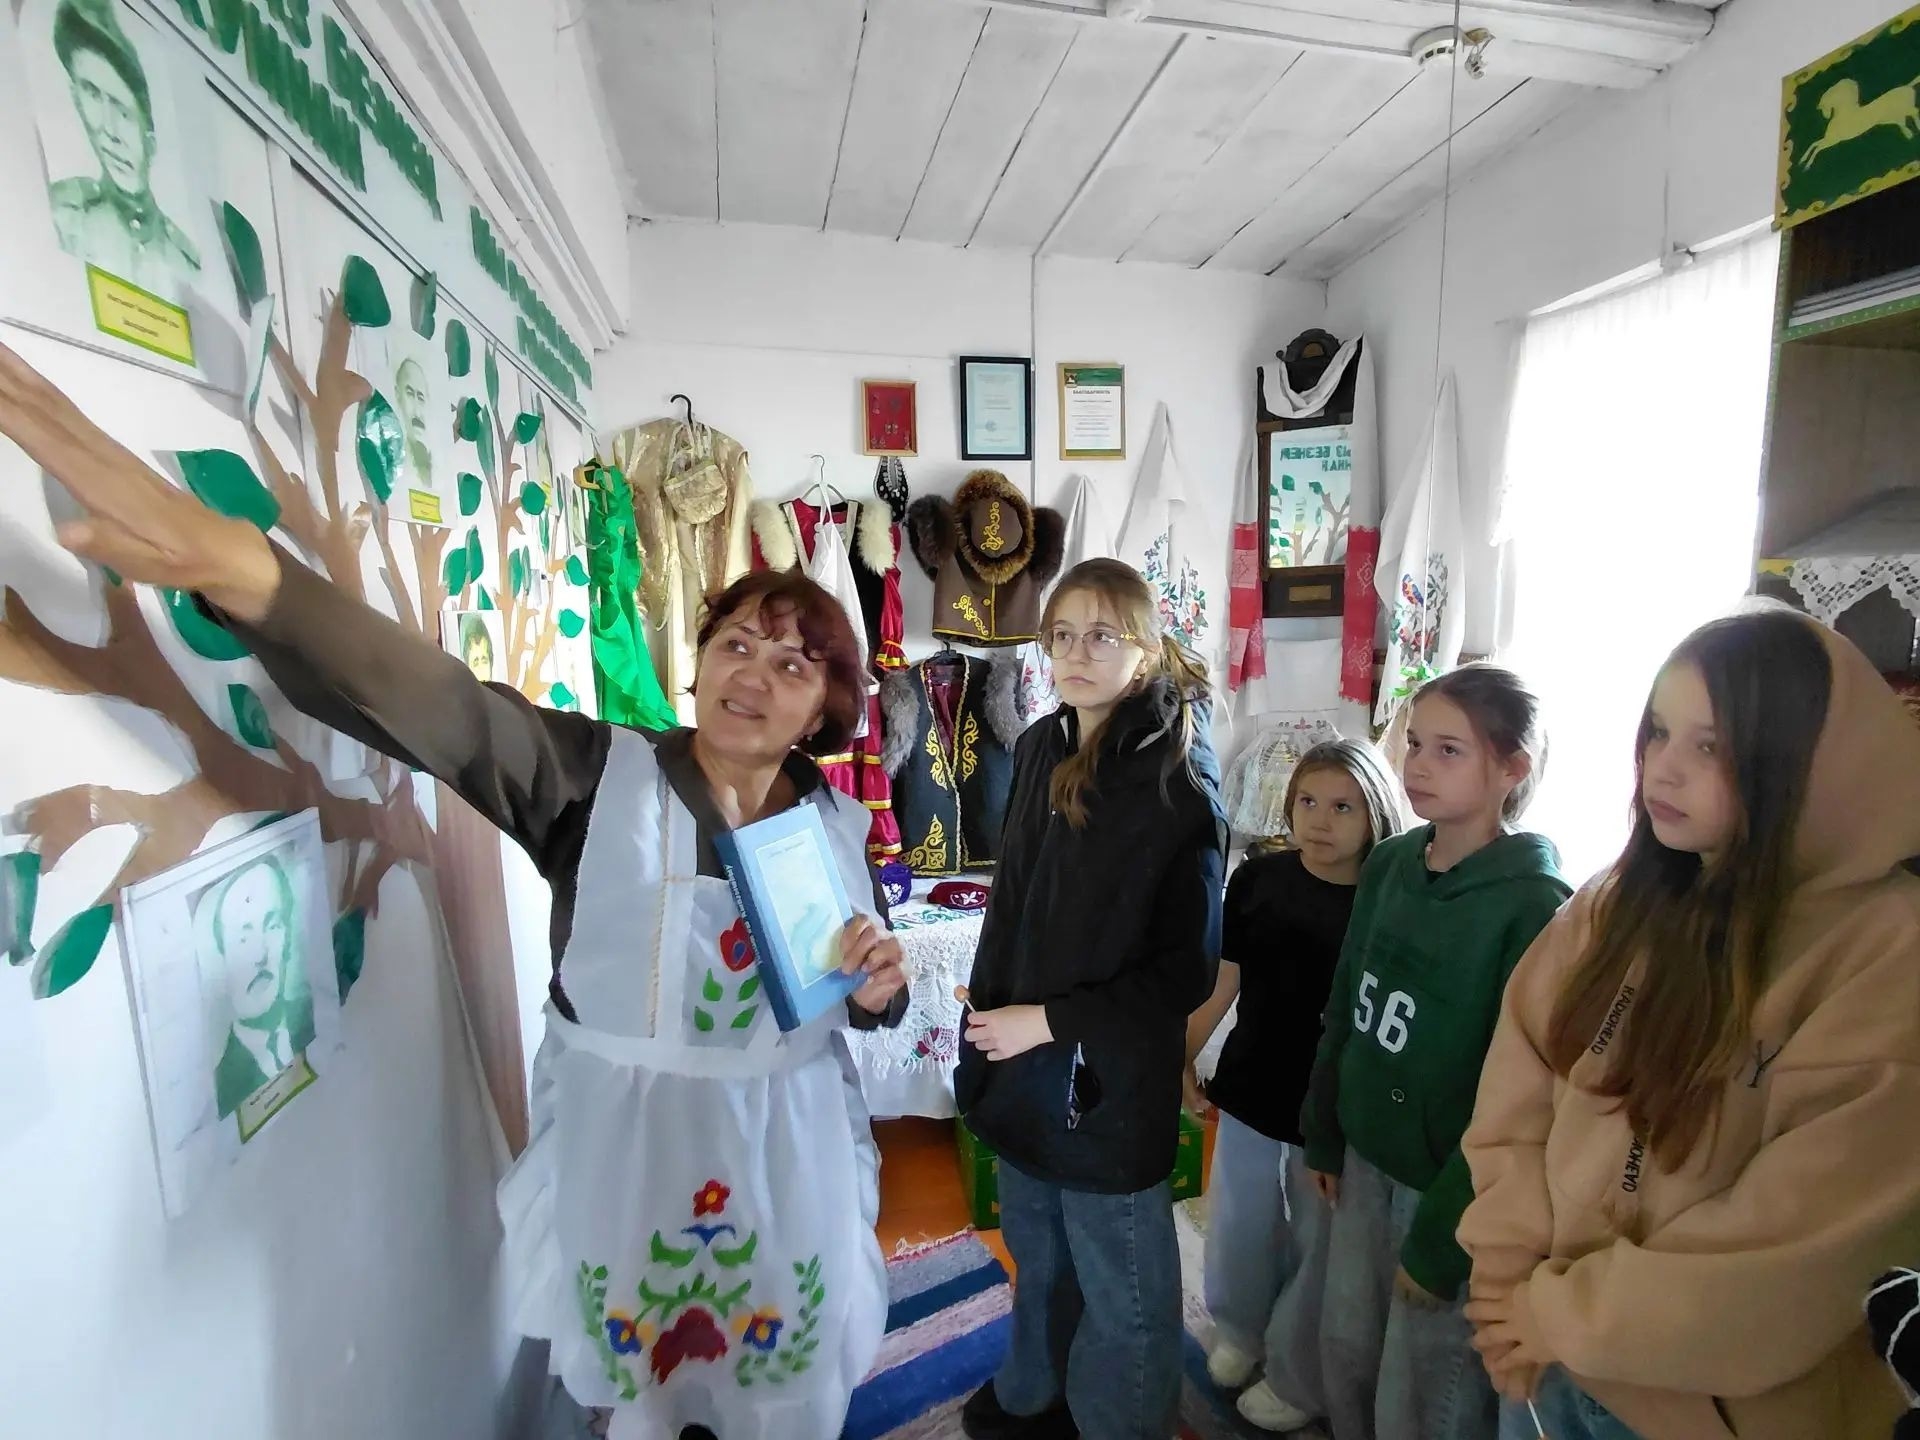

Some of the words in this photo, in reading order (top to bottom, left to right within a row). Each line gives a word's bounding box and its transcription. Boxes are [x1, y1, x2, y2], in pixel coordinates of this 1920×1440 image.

[1354, 970, 1416, 1053] 56
[1591, 985, 1635, 1055] RADIOHEAD
[1621, 1137, 1645, 1193] IOHEAD
